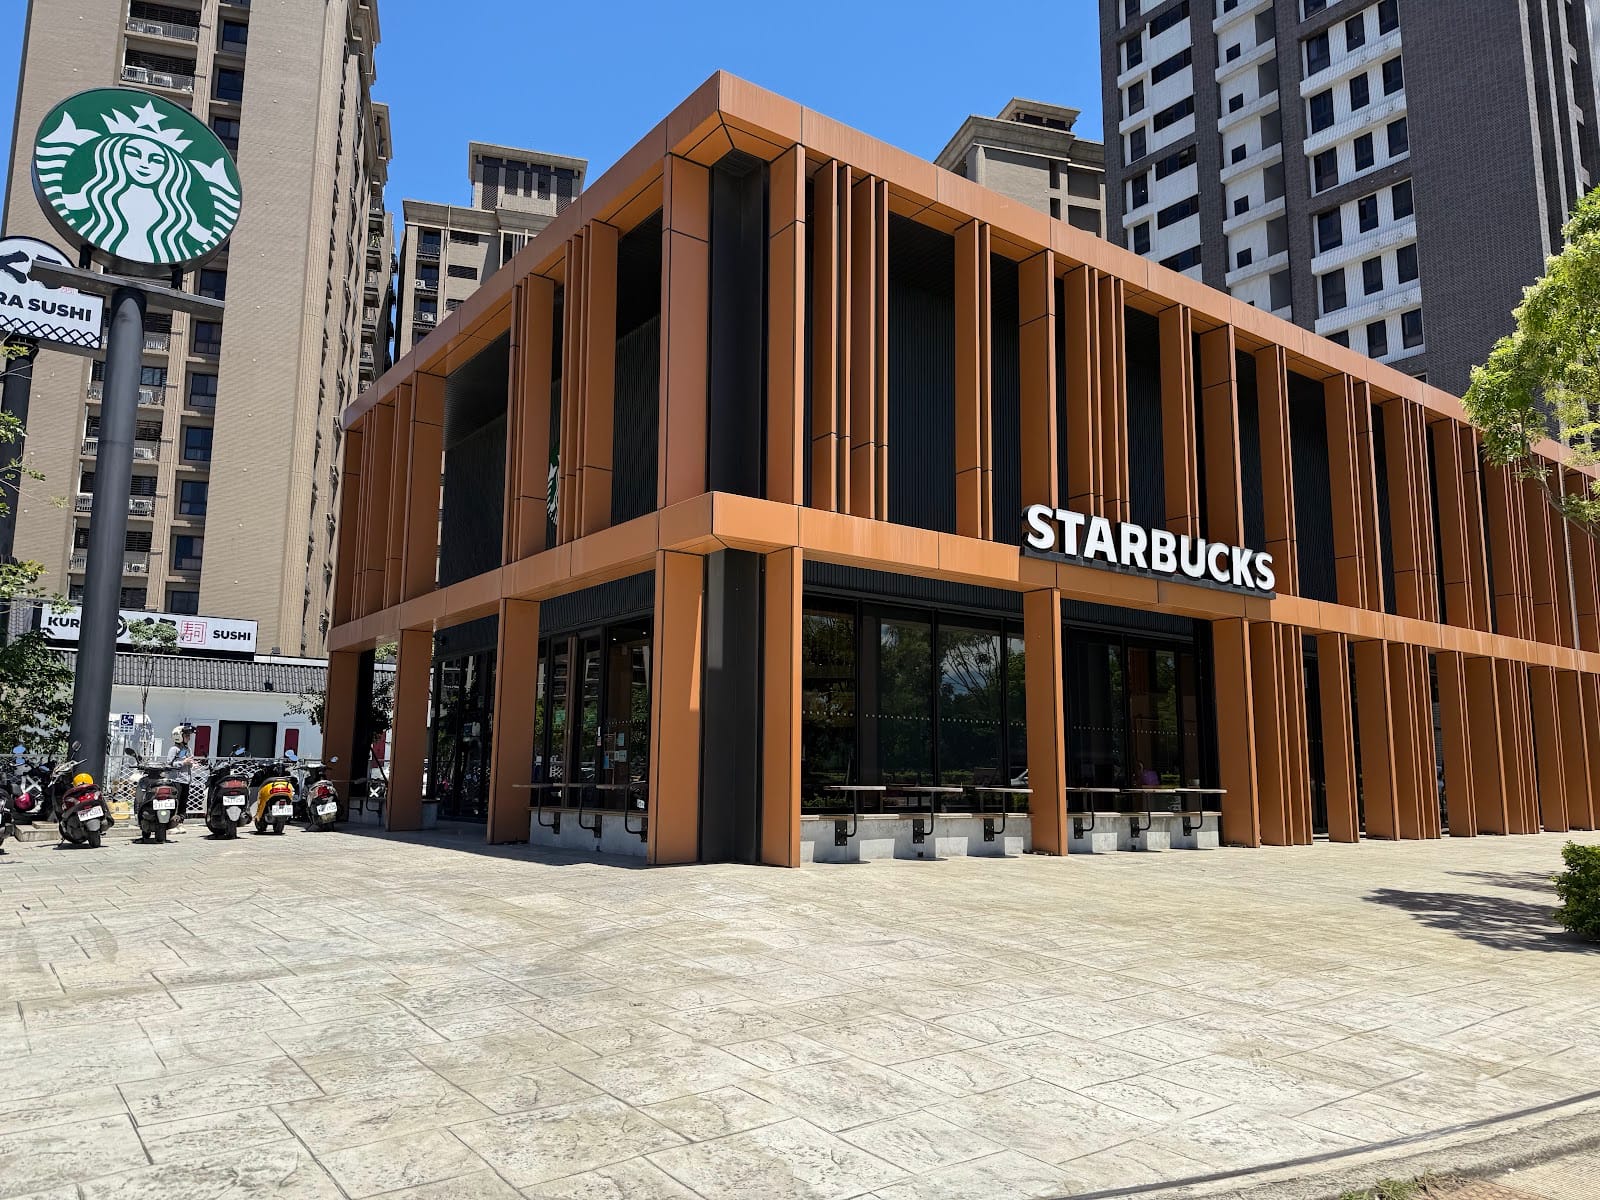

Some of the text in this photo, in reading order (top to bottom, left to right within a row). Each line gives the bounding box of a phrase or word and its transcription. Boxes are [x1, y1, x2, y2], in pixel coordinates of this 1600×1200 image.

[27, 298, 92, 322] SUSHI
[1022, 503, 1276, 591] STARBUCKS
[47, 616, 80, 628] KUR
[212, 629, 251, 641] SUSHI
